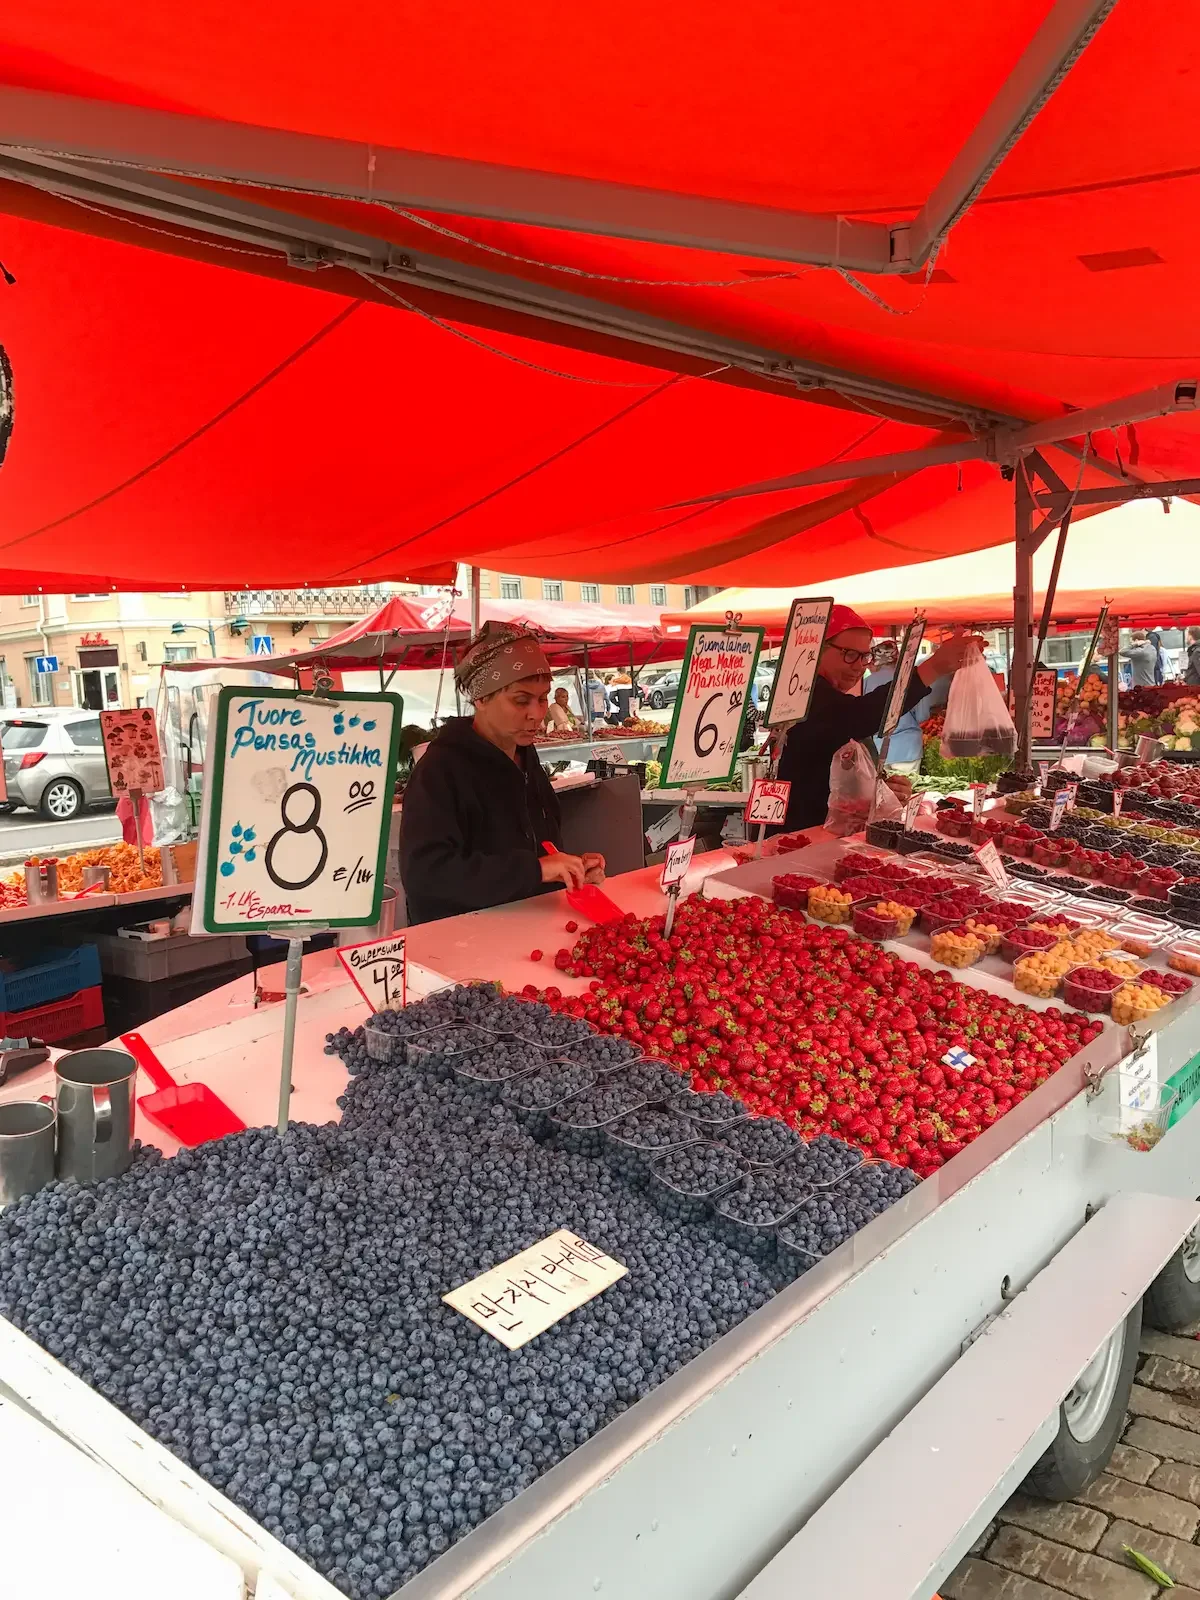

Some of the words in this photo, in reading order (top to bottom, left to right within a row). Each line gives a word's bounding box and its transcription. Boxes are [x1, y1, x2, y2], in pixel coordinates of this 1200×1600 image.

[695, 634, 753, 656] Suomalainen
[788, 648, 806, 696] 6
[237, 699, 307, 727] Tuore
[693, 692, 723, 758] 6
[230, 725, 317, 759] Pensas
[290, 742, 383, 782] Mustikka
[264, 782, 329, 890] 8
[349, 780, 375, 798] 00
[373, 965, 389, 1005] 4
[470, 1269, 566, 1331] 만지지
[541, 1239, 607, 1282] 마세요
